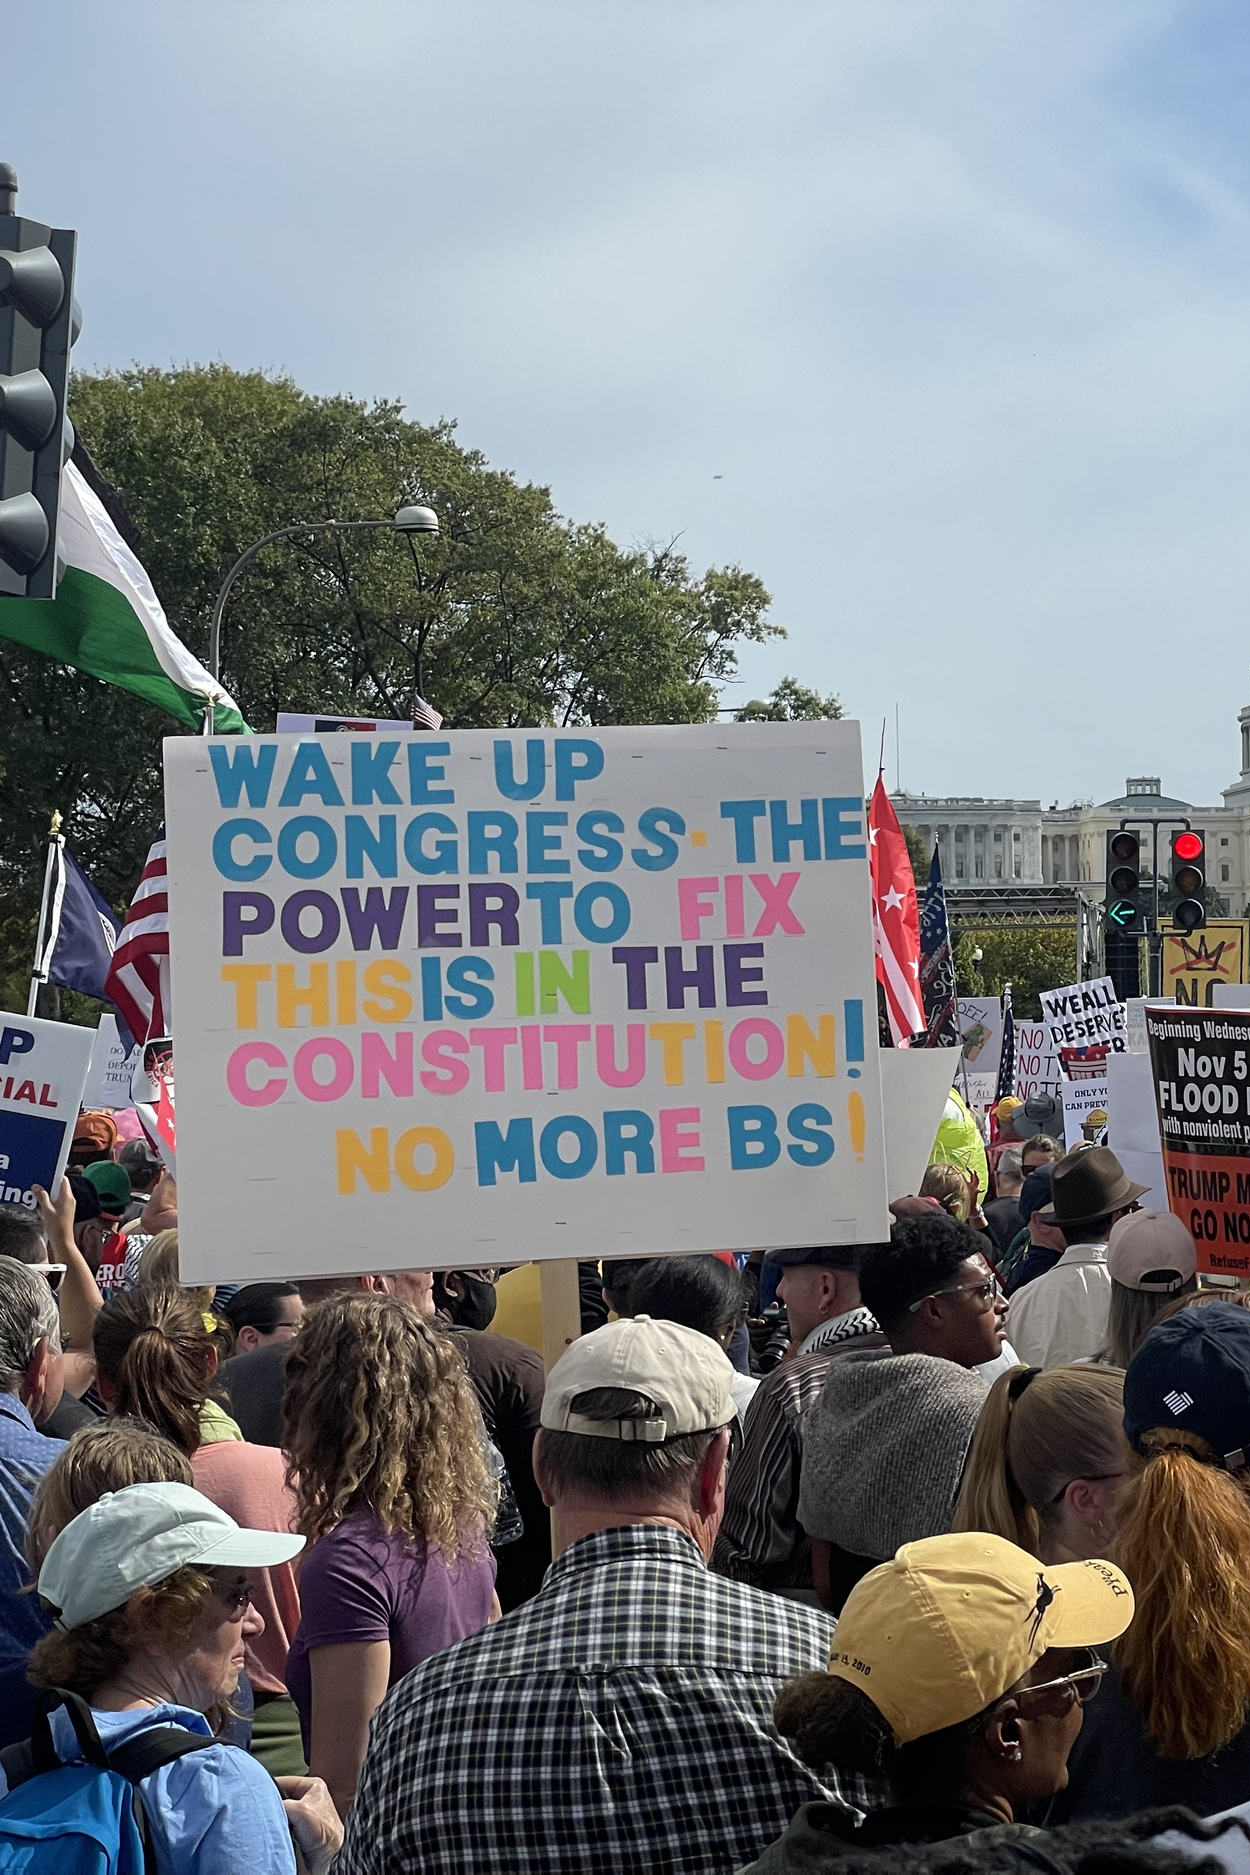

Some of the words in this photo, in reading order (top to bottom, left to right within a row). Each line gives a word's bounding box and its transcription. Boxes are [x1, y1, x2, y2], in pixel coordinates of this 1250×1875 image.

[208, 740, 455, 808] WAKE
[493, 738, 605, 801] UP
[720, 797, 867, 863] THE
[678, 871, 806, 941] FIX
[515, 950, 591, 1017] IN
[612, 943, 768, 1010] THE
[1020, 1028, 1044, 1050] NO
[1050, 1011, 1123, 1044] DESERVE
[1148, 1017, 1200, 1042] Beginning
[226, 999, 865, 1108] CONSTITUTION!
[1018, 1054, 1041, 1076] NO
[1177, 1047, 1226, 1078] Nov
[1233, 1050, 1248, 1080] 5
[1065, 1102, 1083, 1111] CAN
[1084, 1100, 1108, 1110] PREV
[1074, 1088, 1097, 1098] ONLY
[1159, 1081, 1239, 1115] FLOOD
[1161, 1116, 1181, 1135] with
[1183, 1119, 1242, 1139] nonviolent
[335, 1125, 455, 1196] NO
[474, 1107, 705, 1188] MORE
[1168, 1166, 1230, 1203] TRUMP
[1190, 1208, 1218, 1241] GO
[851, 1658, 872, 1676] 2010
